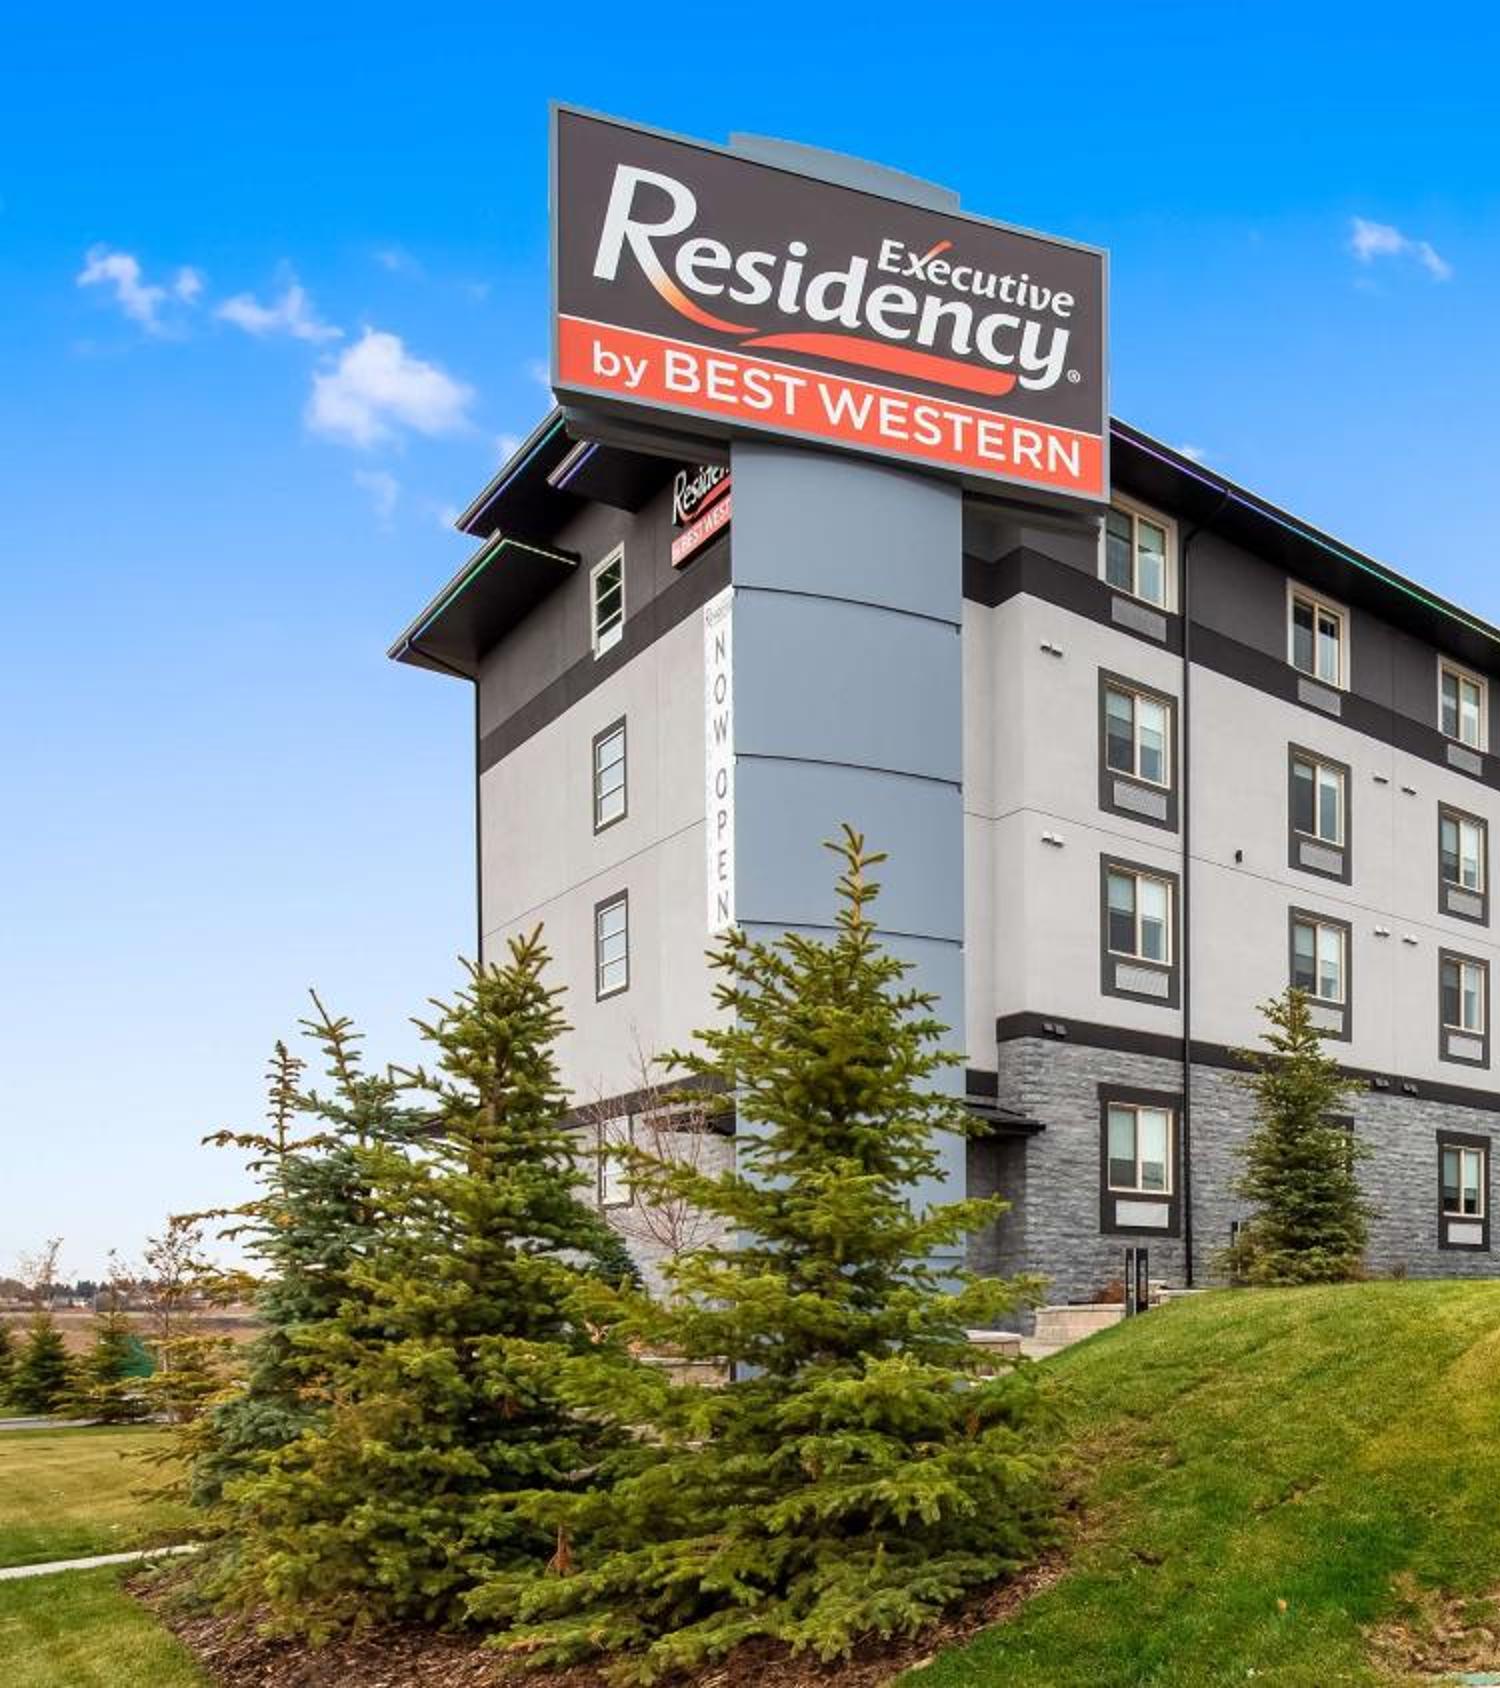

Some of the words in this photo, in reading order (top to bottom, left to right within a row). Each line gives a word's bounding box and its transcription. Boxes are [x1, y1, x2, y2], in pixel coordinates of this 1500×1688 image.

[877, 238, 1076, 318] Executive
[592, 341, 648, 388] by
[664, 349, 807, 416] BEST
[817, 383, 1081, 478] WESTERN
[713, 630, 730, 746] NOW
[714, 767, 729, 923] OPEN
